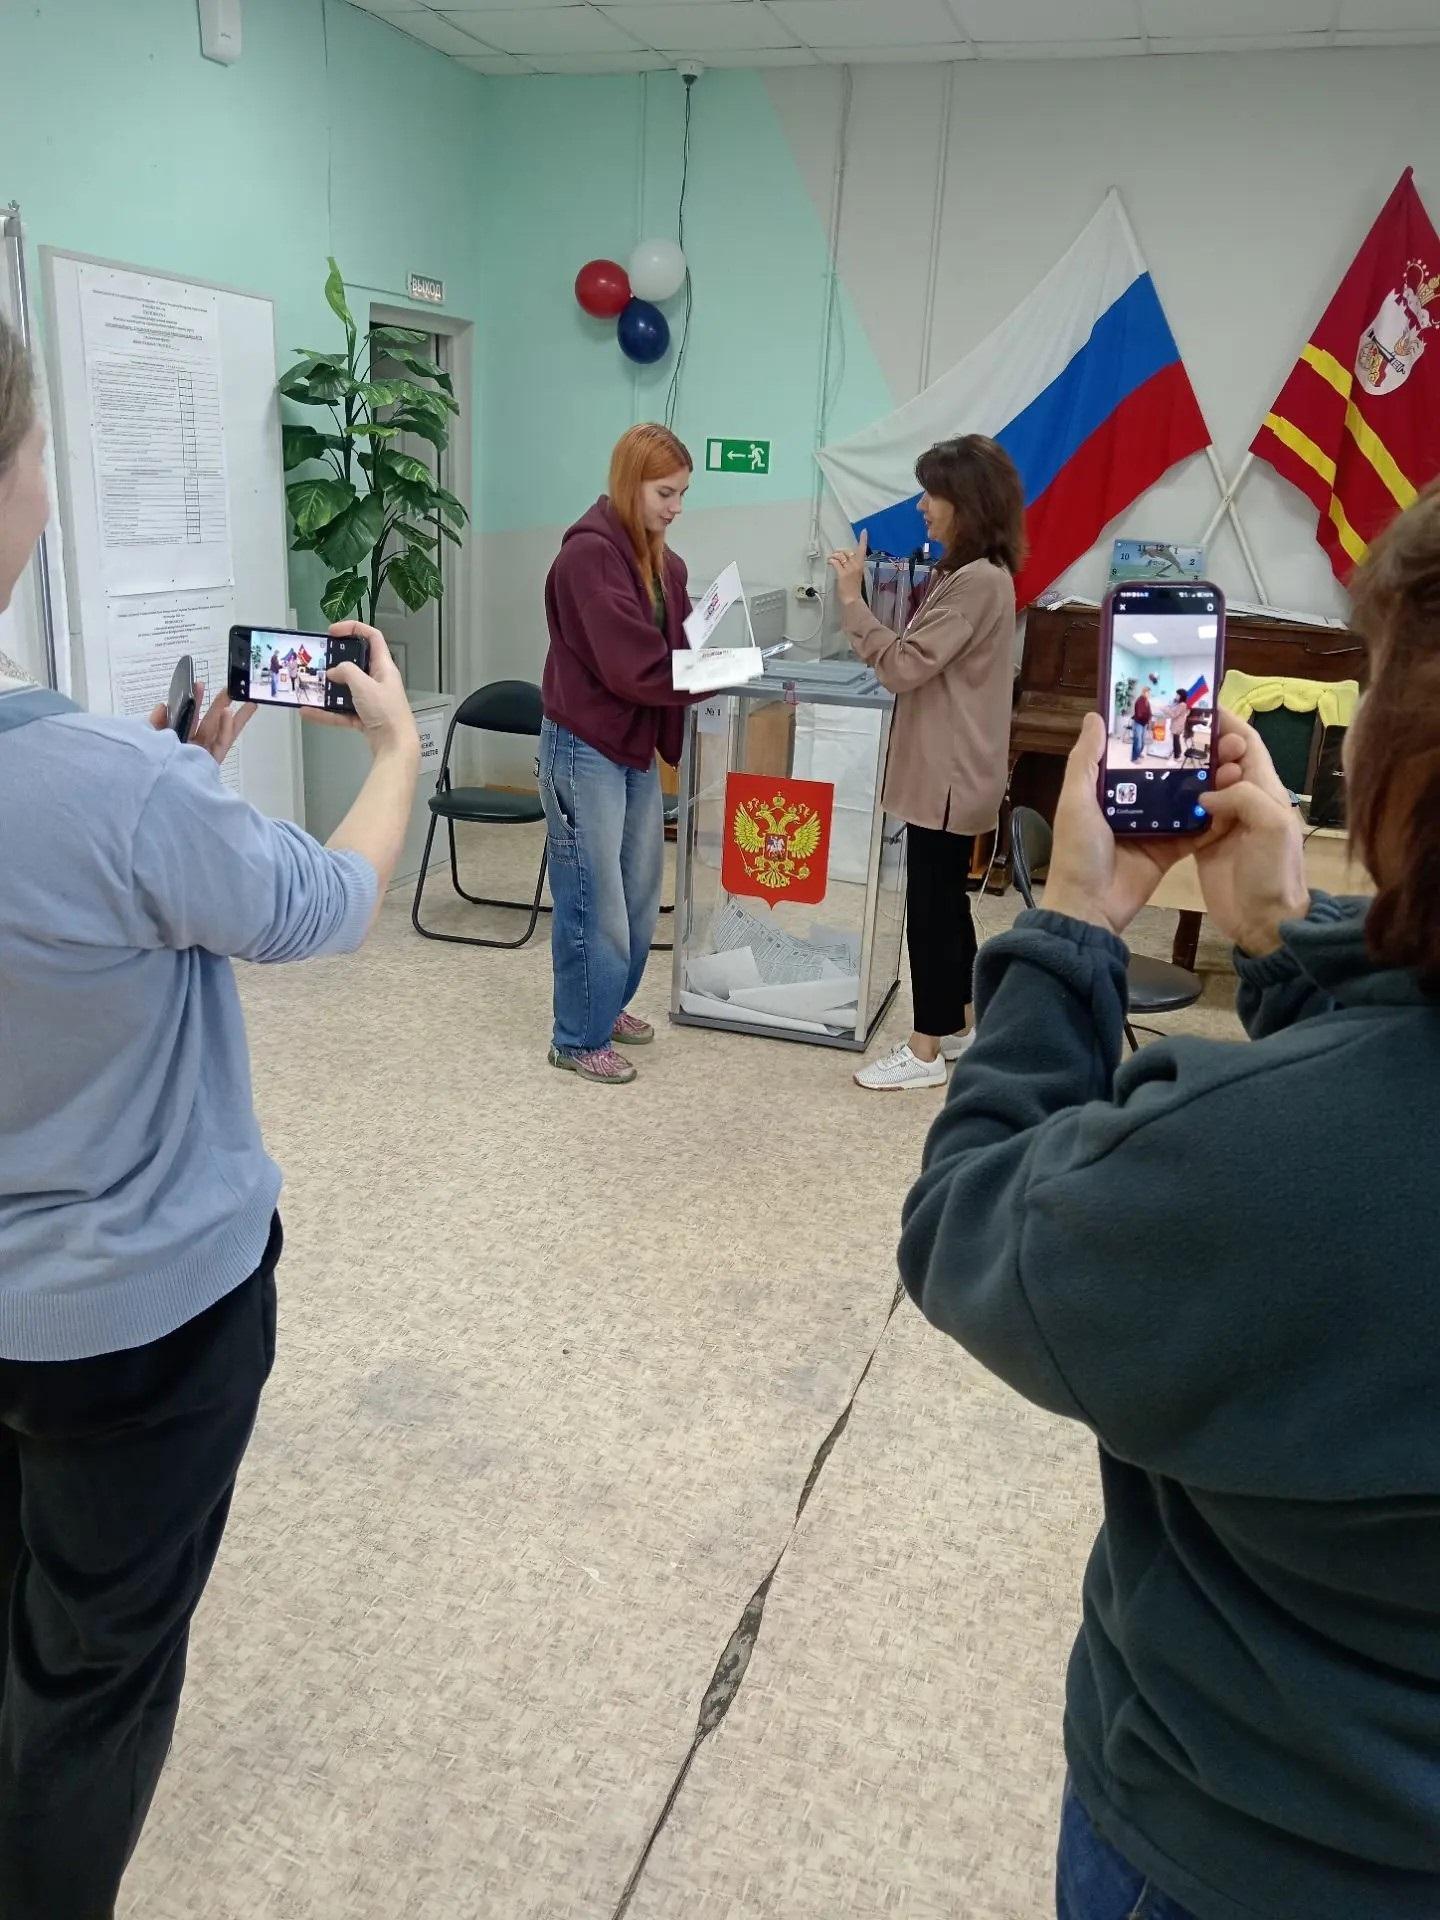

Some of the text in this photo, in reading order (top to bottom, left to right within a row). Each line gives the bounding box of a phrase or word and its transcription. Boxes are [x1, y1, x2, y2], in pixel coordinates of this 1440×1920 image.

[412, 276, 441, 298] ВЫХОД
[1120, 552, 1130, 561] 10
[1189, 558, 1195, 566] 2
